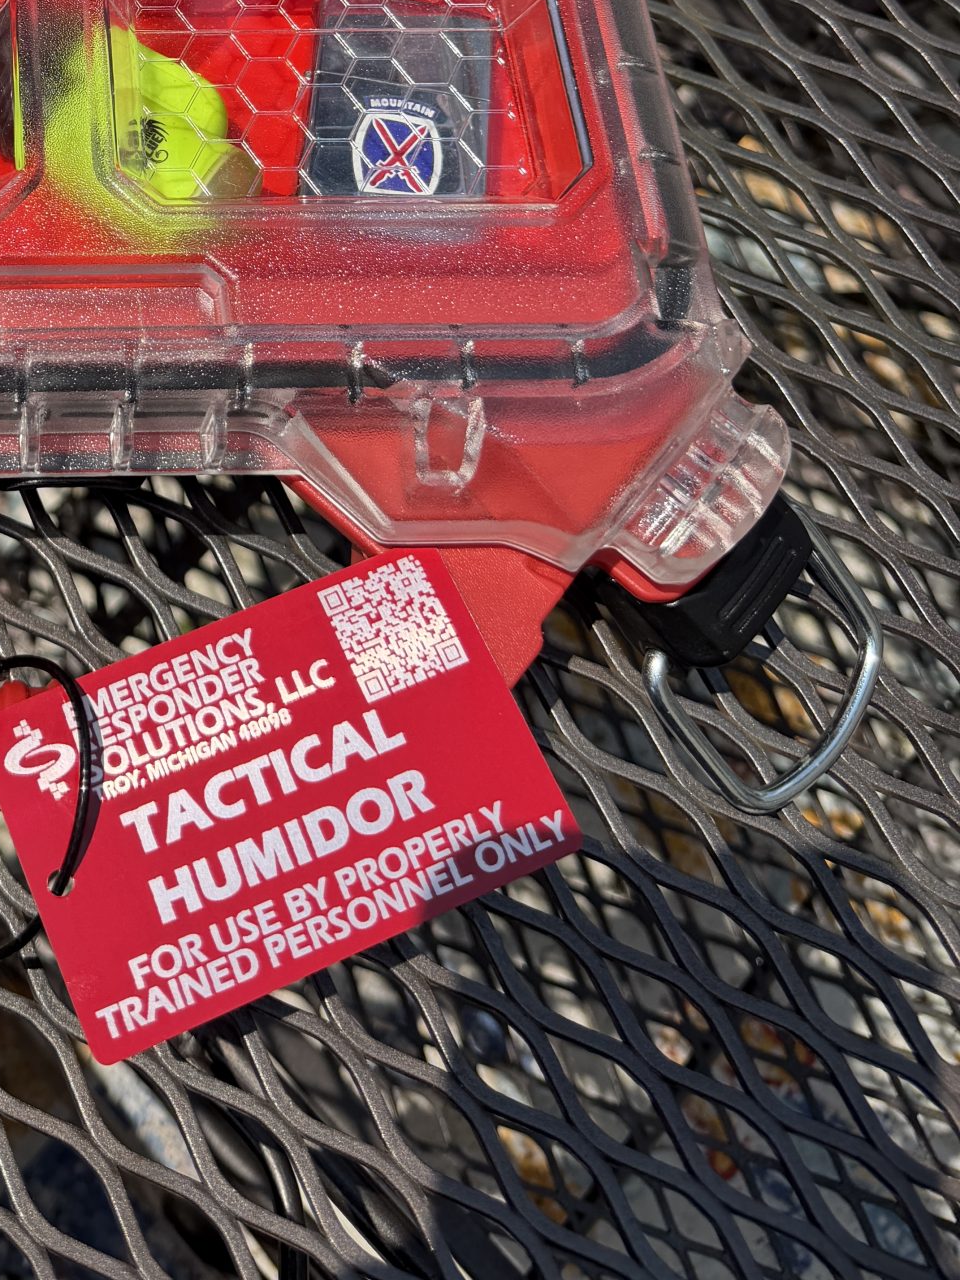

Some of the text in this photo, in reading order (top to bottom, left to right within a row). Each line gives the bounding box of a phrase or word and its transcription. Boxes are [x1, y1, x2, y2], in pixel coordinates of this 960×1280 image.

[369, 98, 436, 118] MOUNTAIN
[146, 729, 238, 783] MICHIGAN
[239, 707, 292, 741] 48098
[275, 658, 336, 704] LLC
[120, 709, 407, 854] TACTICAL
[147, 768, 435, 925] HUMIDOR
[95, 809, 566, 1039] TRAINED PERSONNEL ONLY
[128, 800, 505, 990] FOR USE BY PROPERLY
